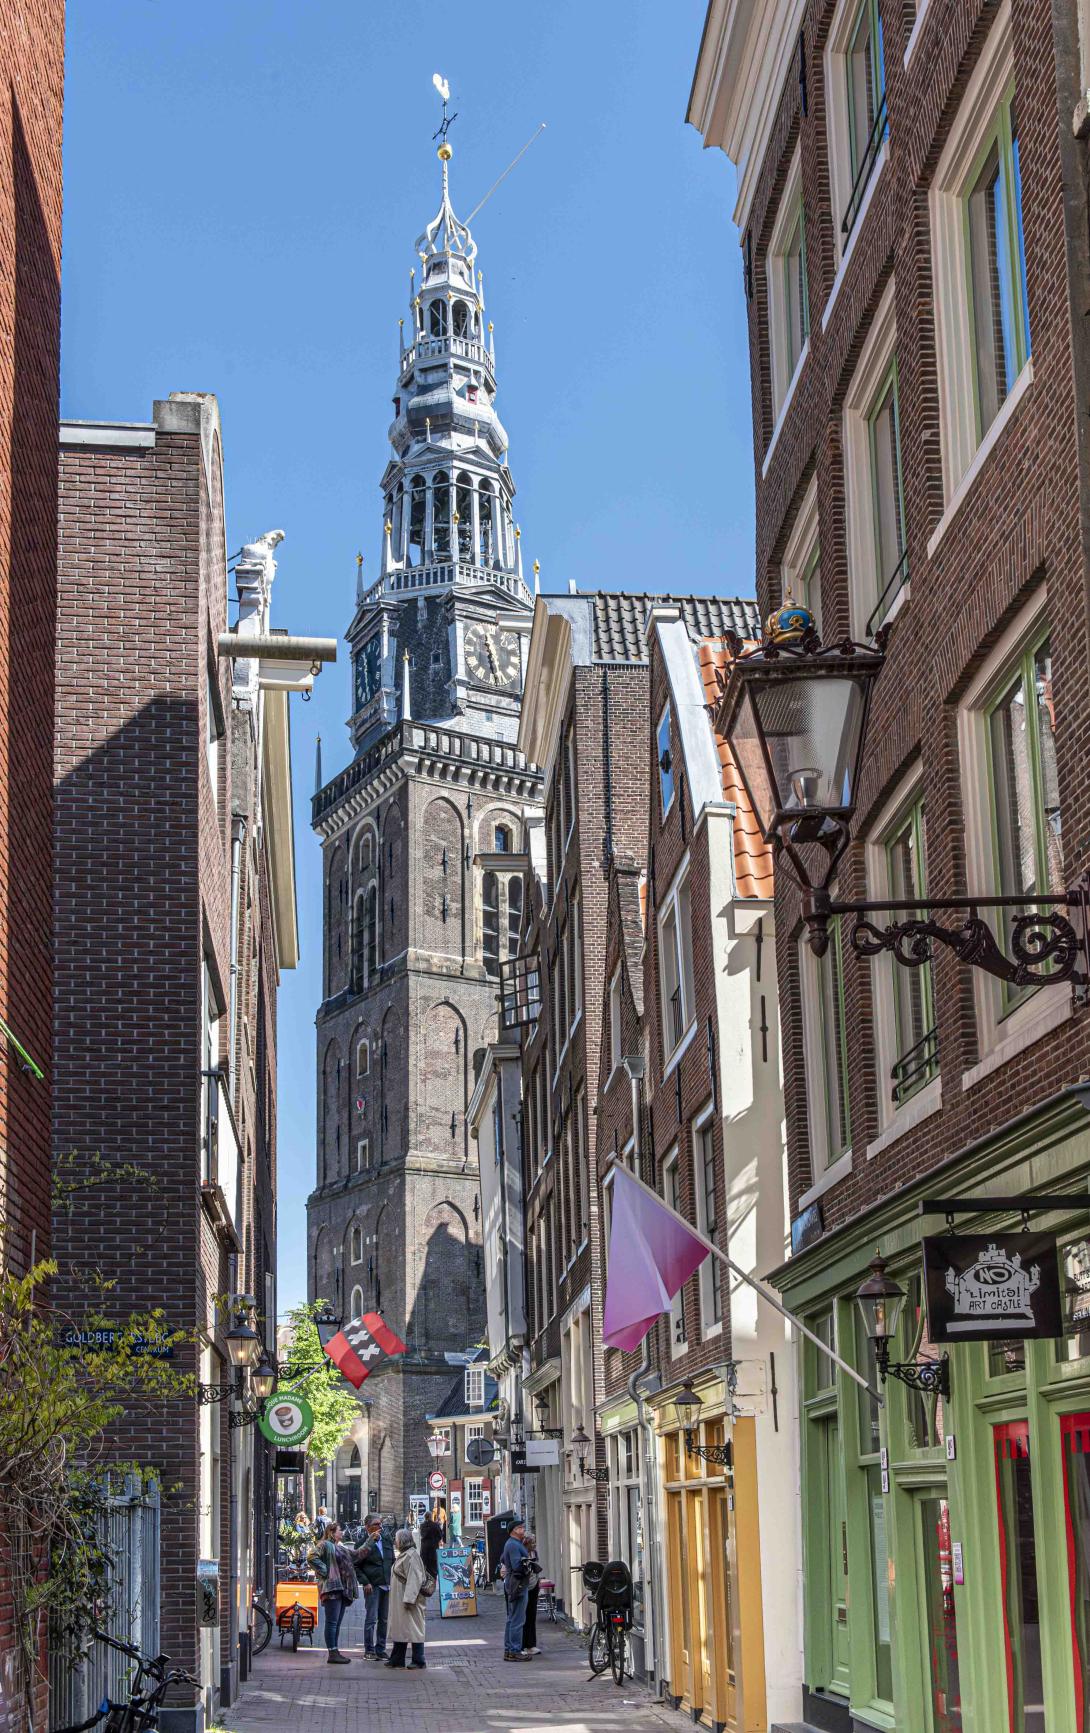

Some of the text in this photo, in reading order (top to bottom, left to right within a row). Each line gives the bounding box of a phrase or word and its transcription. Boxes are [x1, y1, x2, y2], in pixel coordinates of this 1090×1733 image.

[978, 1267, 1008, 1284] NO
[969, 1298, 1022, 1311] ART CASTLE
[135, 1345, 169, 1353] CENRUM
[279, 1395, 303, 1404] MADAME
[273, 1425, 309, 1443] LUNCHROOM
